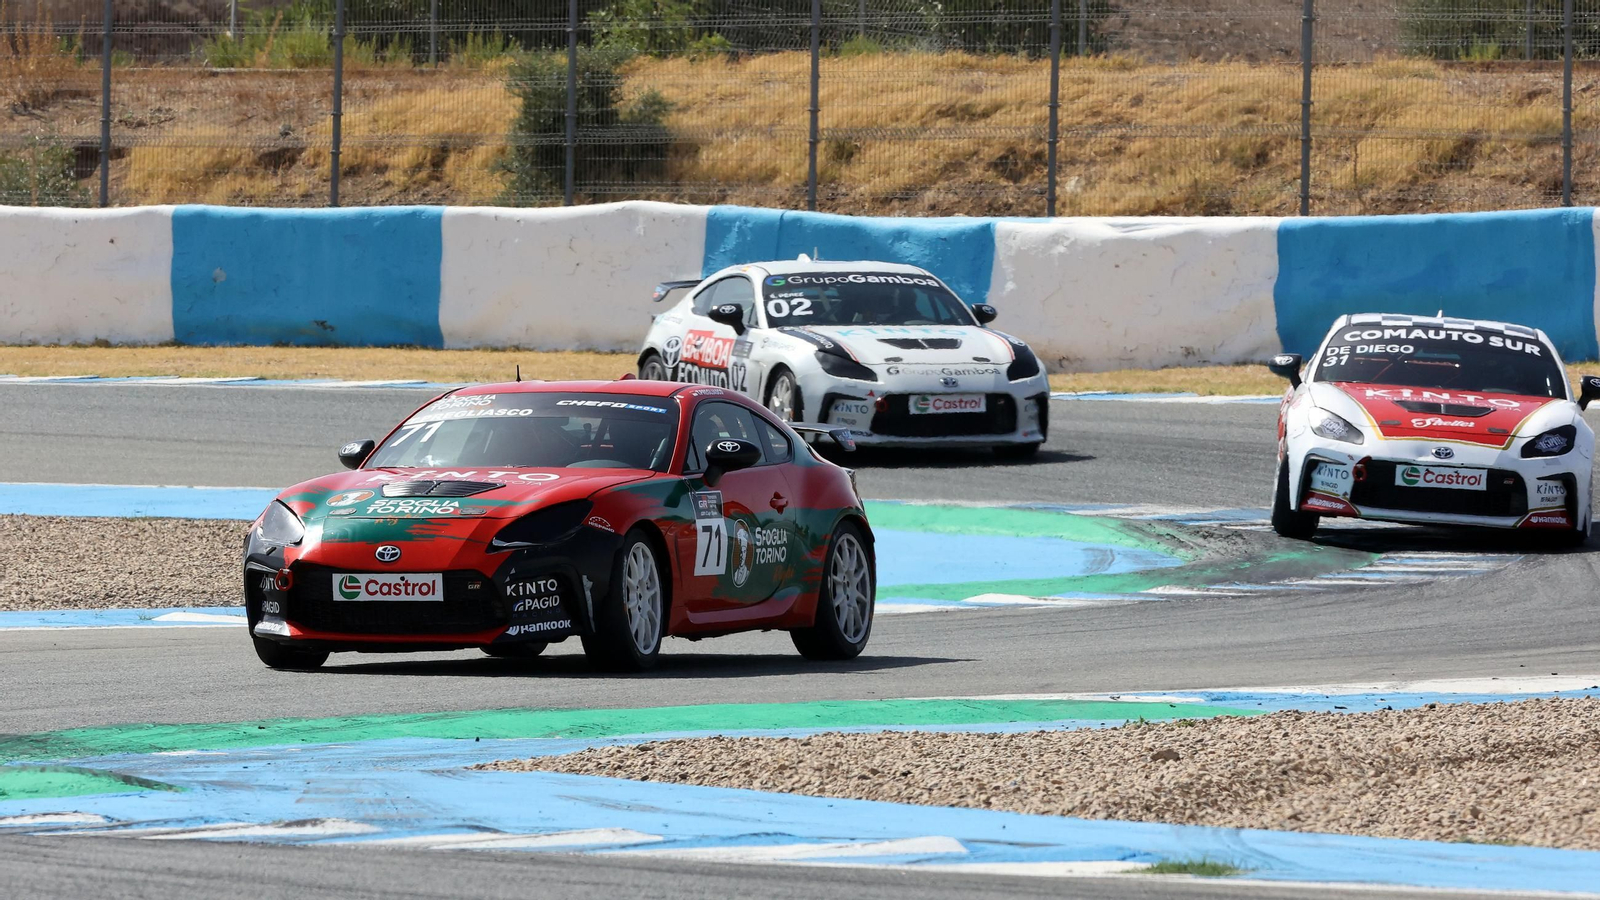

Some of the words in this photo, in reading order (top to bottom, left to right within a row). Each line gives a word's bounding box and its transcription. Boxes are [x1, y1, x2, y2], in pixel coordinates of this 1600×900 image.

[787, 274, 940, 288] GrupoGamboa
[766, 297, 814, 318] 02
[682, 332, 732, 368] GAMBOA
[1326, 345, 1351, 357] DE
[1356, 344, 1415, 354] DIEGO
[1343, 328, 1485, 344] COMAUTO
[1488, 335, 1542, 357] SUR
[1322, 354, 1349, 368] 31
[731, 361, 748, 393] 02
[901, 366, 1001, 377] GrupoGamboa
[430, 400, 492, 412] TORINO
[932, 398, 982, 412] Castrol
[389, 420, 446, 448] 71
[1423, 470, 1483, 487] Castrol
[366, 506, 455, 515] TORINO
[371, 499, 460, 508] SFOGLIA
[755, 526, 788, 546] SFOGLIA
[701, 523, 721, 568] 71
[755, 546, 787, 565] TORINO
[364, 578, 436, 597] Castrol
[524, 595, 560, 611] PAGID
